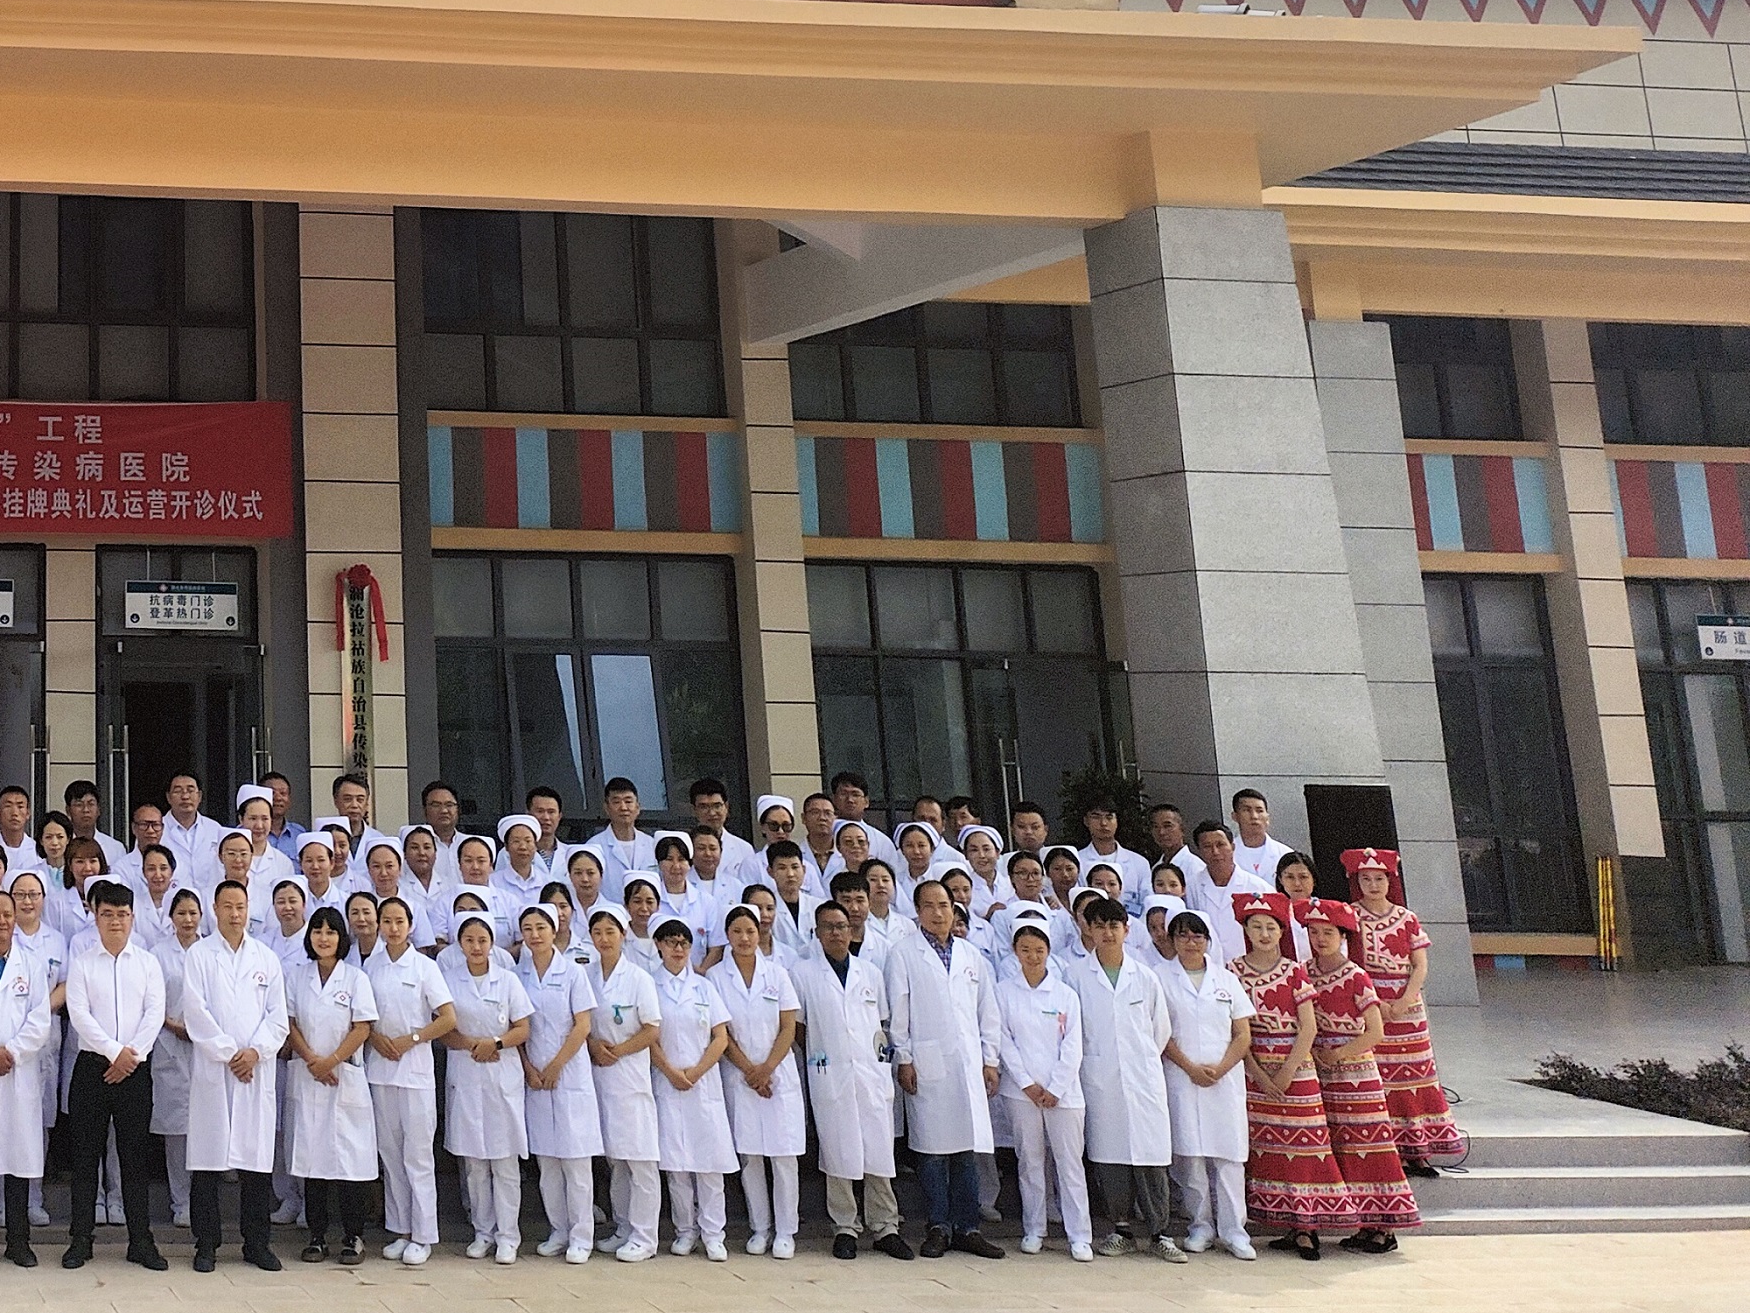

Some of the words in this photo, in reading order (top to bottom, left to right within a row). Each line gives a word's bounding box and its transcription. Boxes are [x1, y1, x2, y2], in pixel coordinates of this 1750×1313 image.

[149, 594, 215, 607] 抗病毒门诊
[149, 607, 215, 620] 登革热门诊
